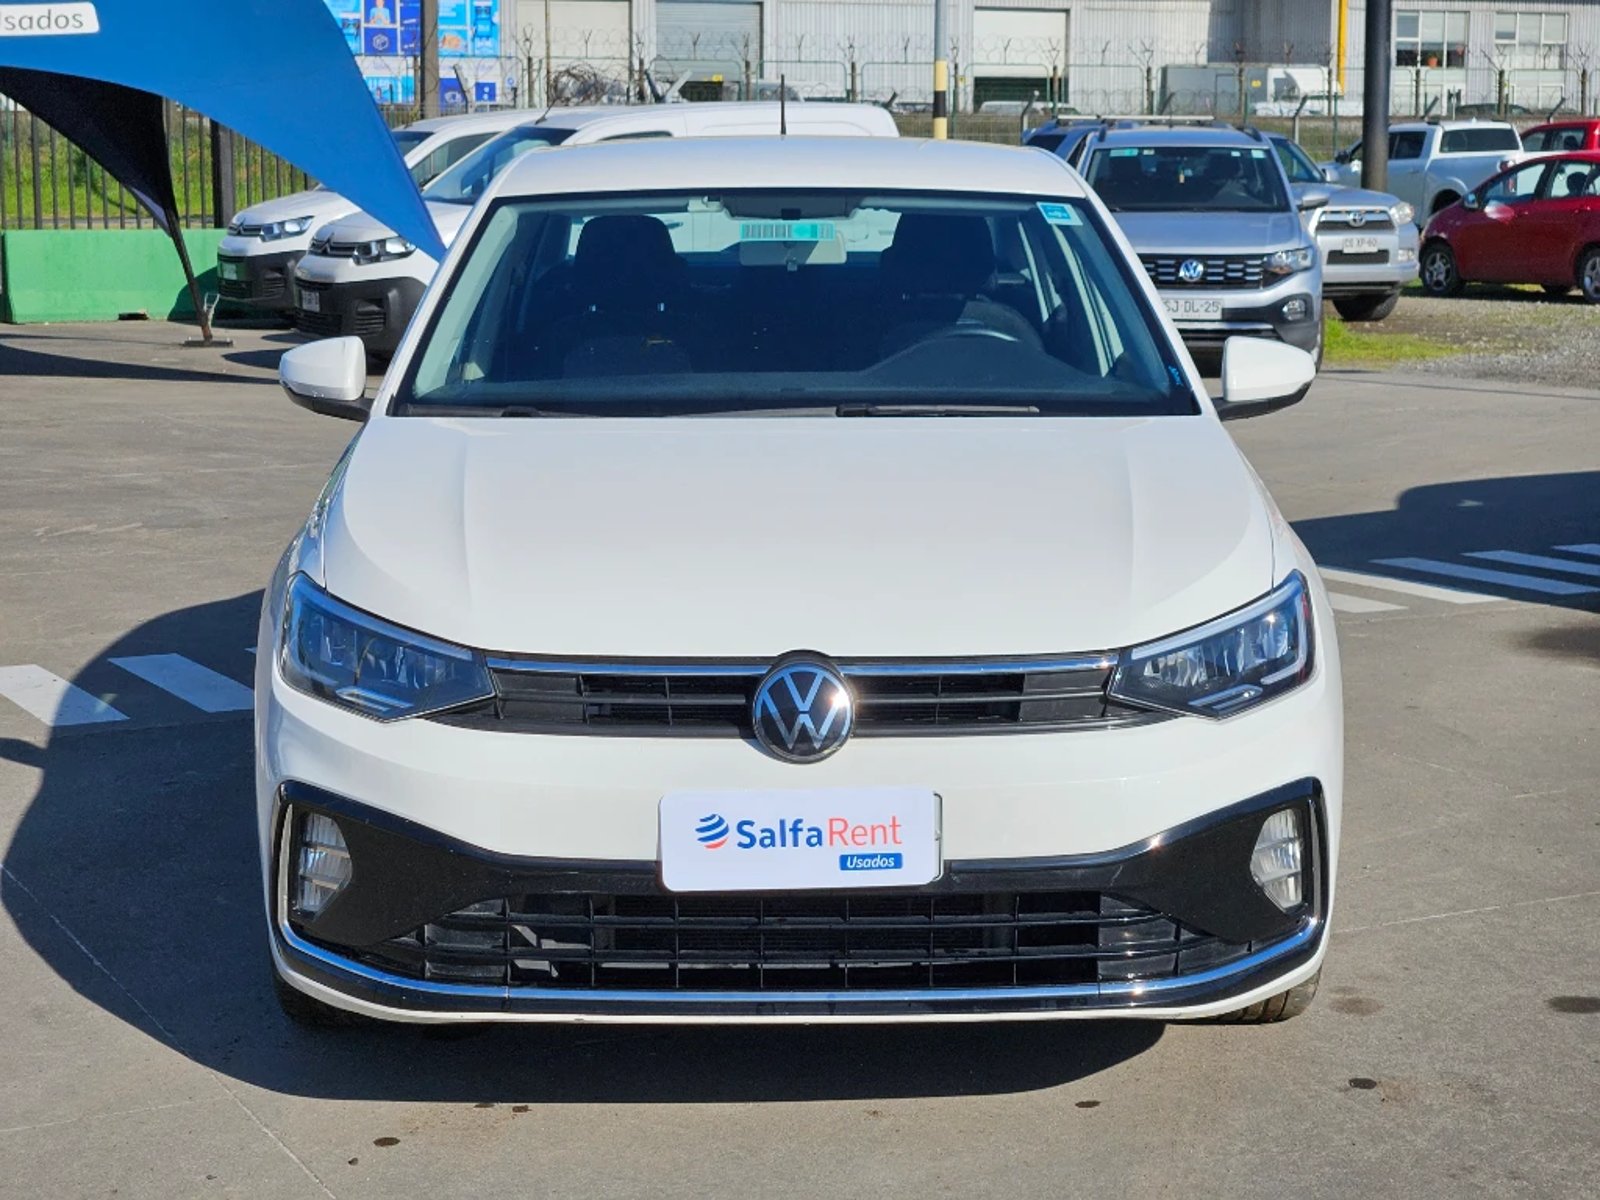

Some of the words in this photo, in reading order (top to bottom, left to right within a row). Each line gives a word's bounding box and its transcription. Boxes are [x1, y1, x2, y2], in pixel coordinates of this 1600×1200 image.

[0, 8, 84, 31] sados
[736, 815, 903, 849] SalfaRent
[846, 854, 895, 869] Usados
